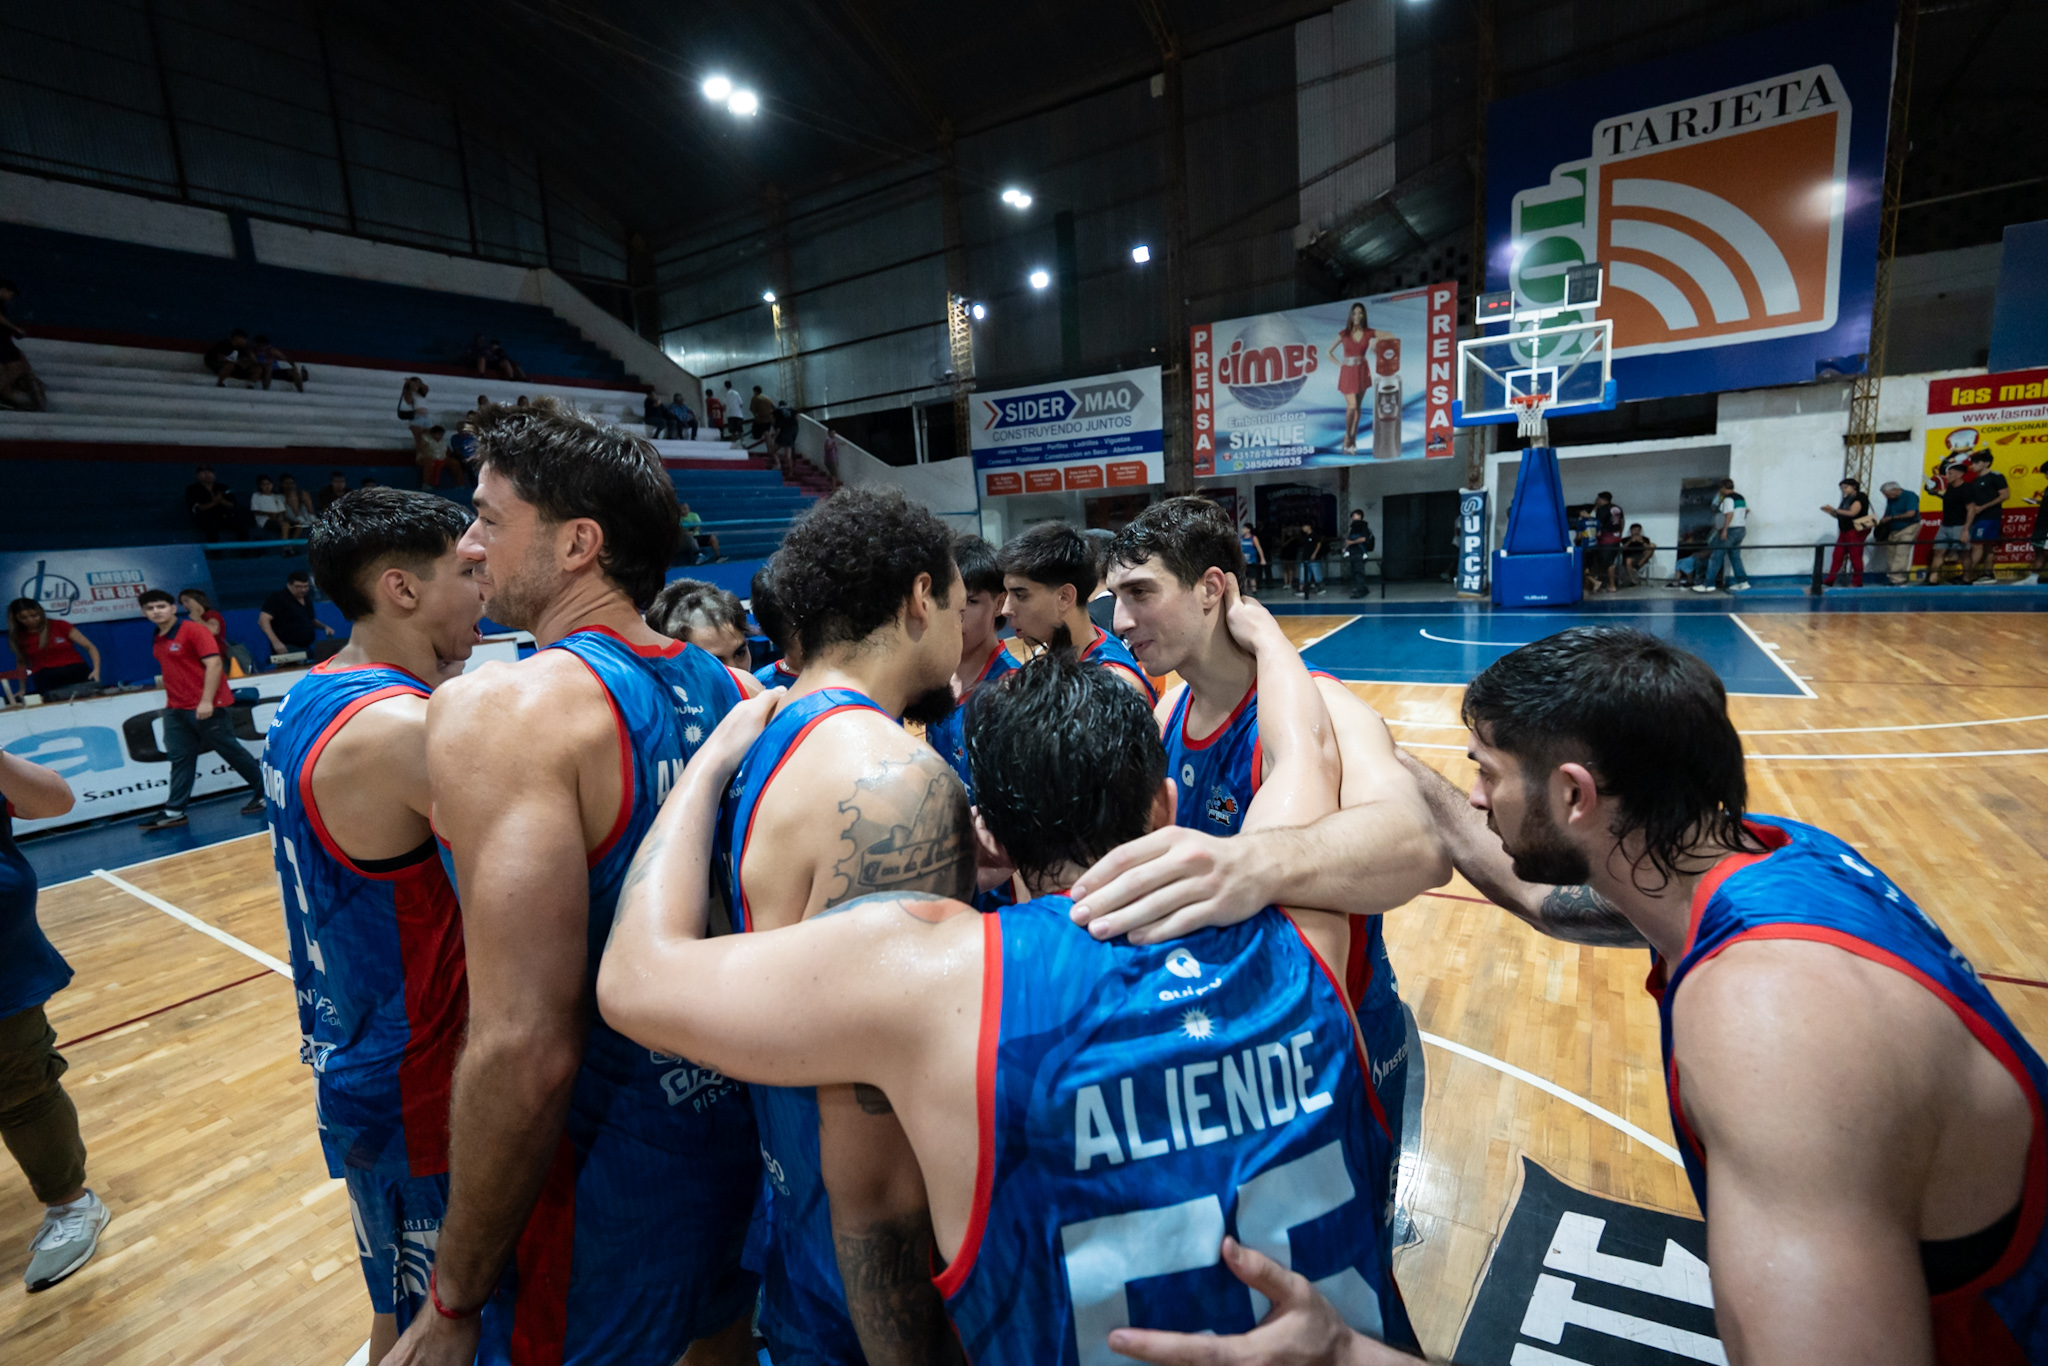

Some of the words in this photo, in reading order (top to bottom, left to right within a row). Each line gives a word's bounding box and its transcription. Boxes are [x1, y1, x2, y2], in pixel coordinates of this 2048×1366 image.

[1602, 74, 1836, 156] TARJETA
[1430, 290, 1451, 429] PRENSA
[1005, 397, 1065, 423] SIDER
[1085, 388, 1131, 412] MAQ
[1194, 331, 1211, 451] PRENSA
[1951, 387, 1992, 406] las
[992, 422, 1082, 442] CONSTRUYENDO
[1085, 415, 1132, 432] JUNTOS
[1229, 412, 1306, 427] Embotelladora
[1962, 405, 2048, 423] www.lasmal
[1229, 425, 1305, 450] SIALLE
[1463, 515, 1481, 590] UPCN
[1075, 1031, 1334, 1171] ALIENDE
